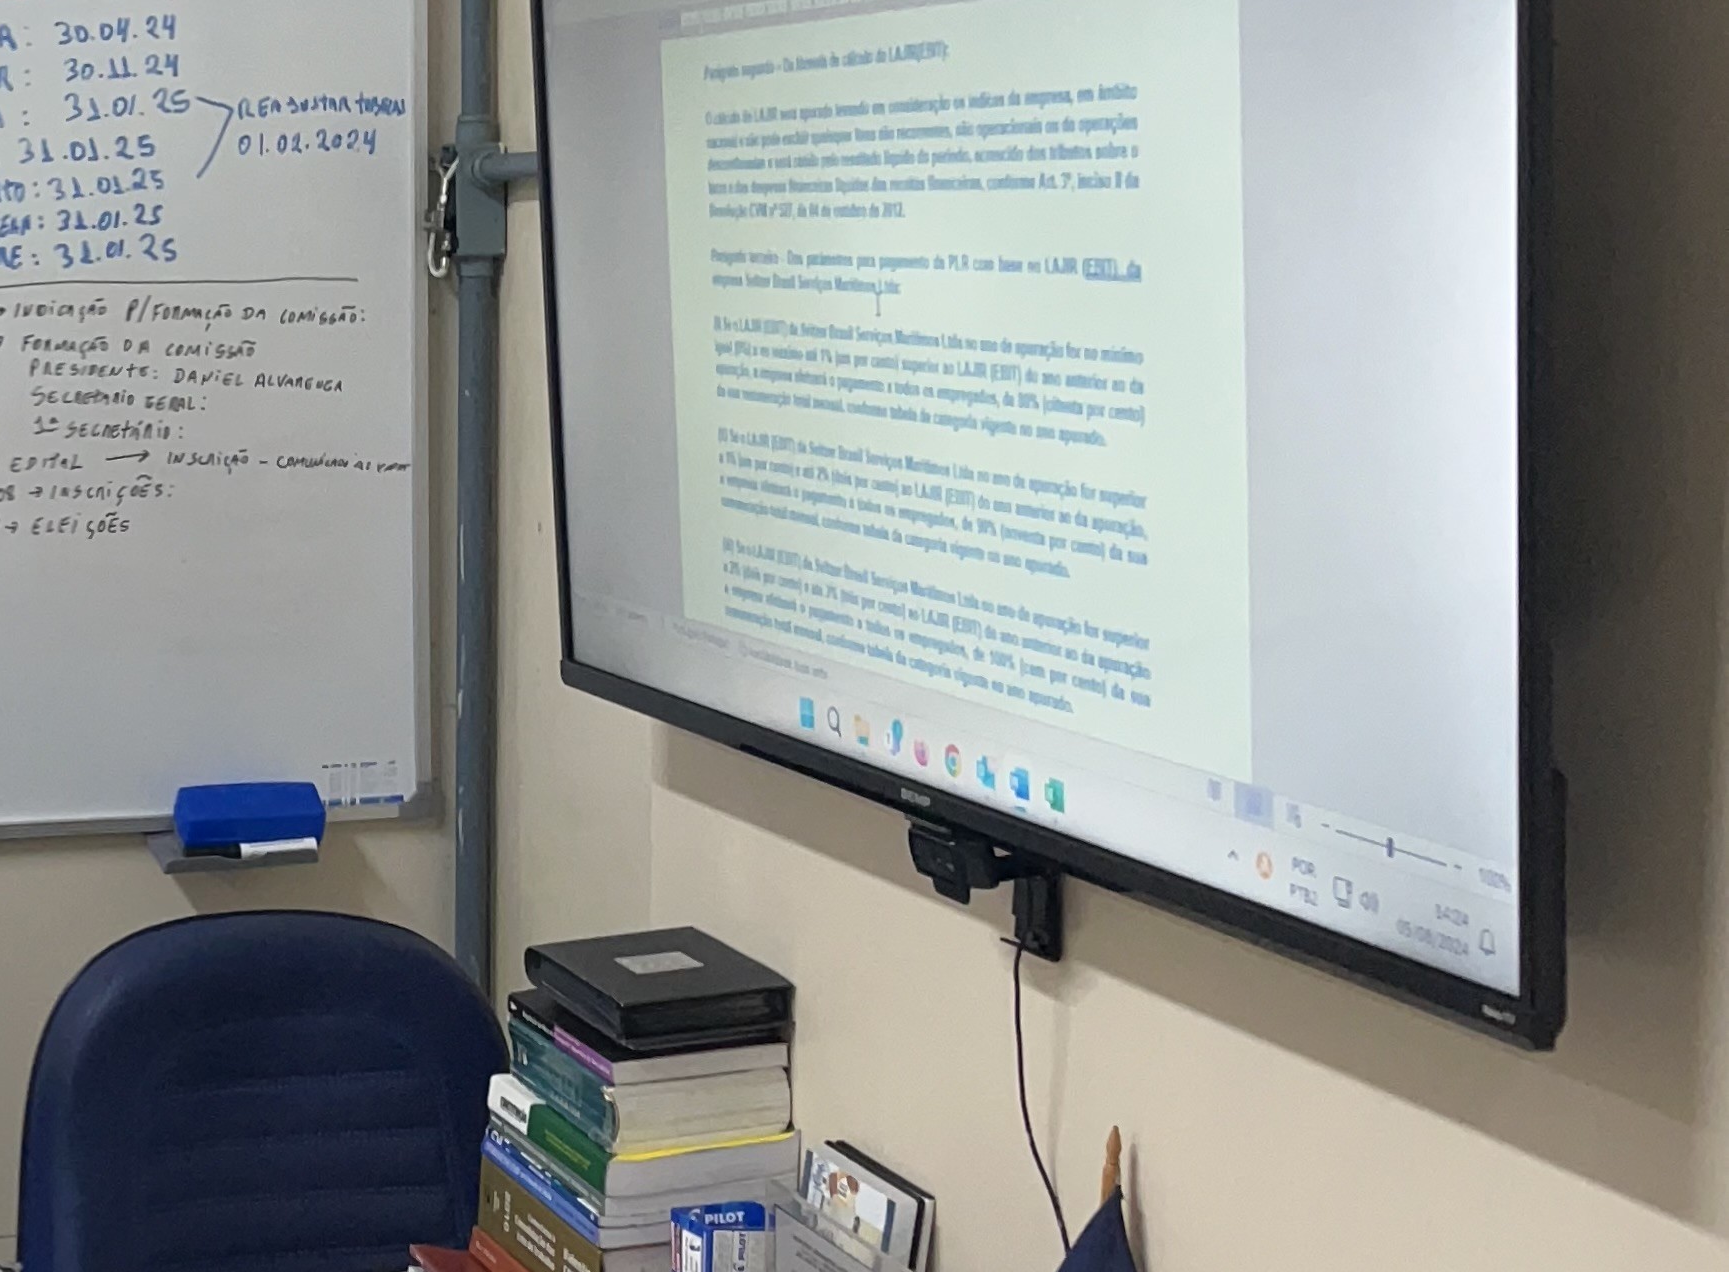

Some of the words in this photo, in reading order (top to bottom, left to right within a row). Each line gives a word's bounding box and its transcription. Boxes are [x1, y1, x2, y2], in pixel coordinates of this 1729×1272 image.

[53, 14, 177, 45] 30.04.24
[173, 367, 244, 388] DANIEL
[705, 1210, 746, 1225] PILOT
